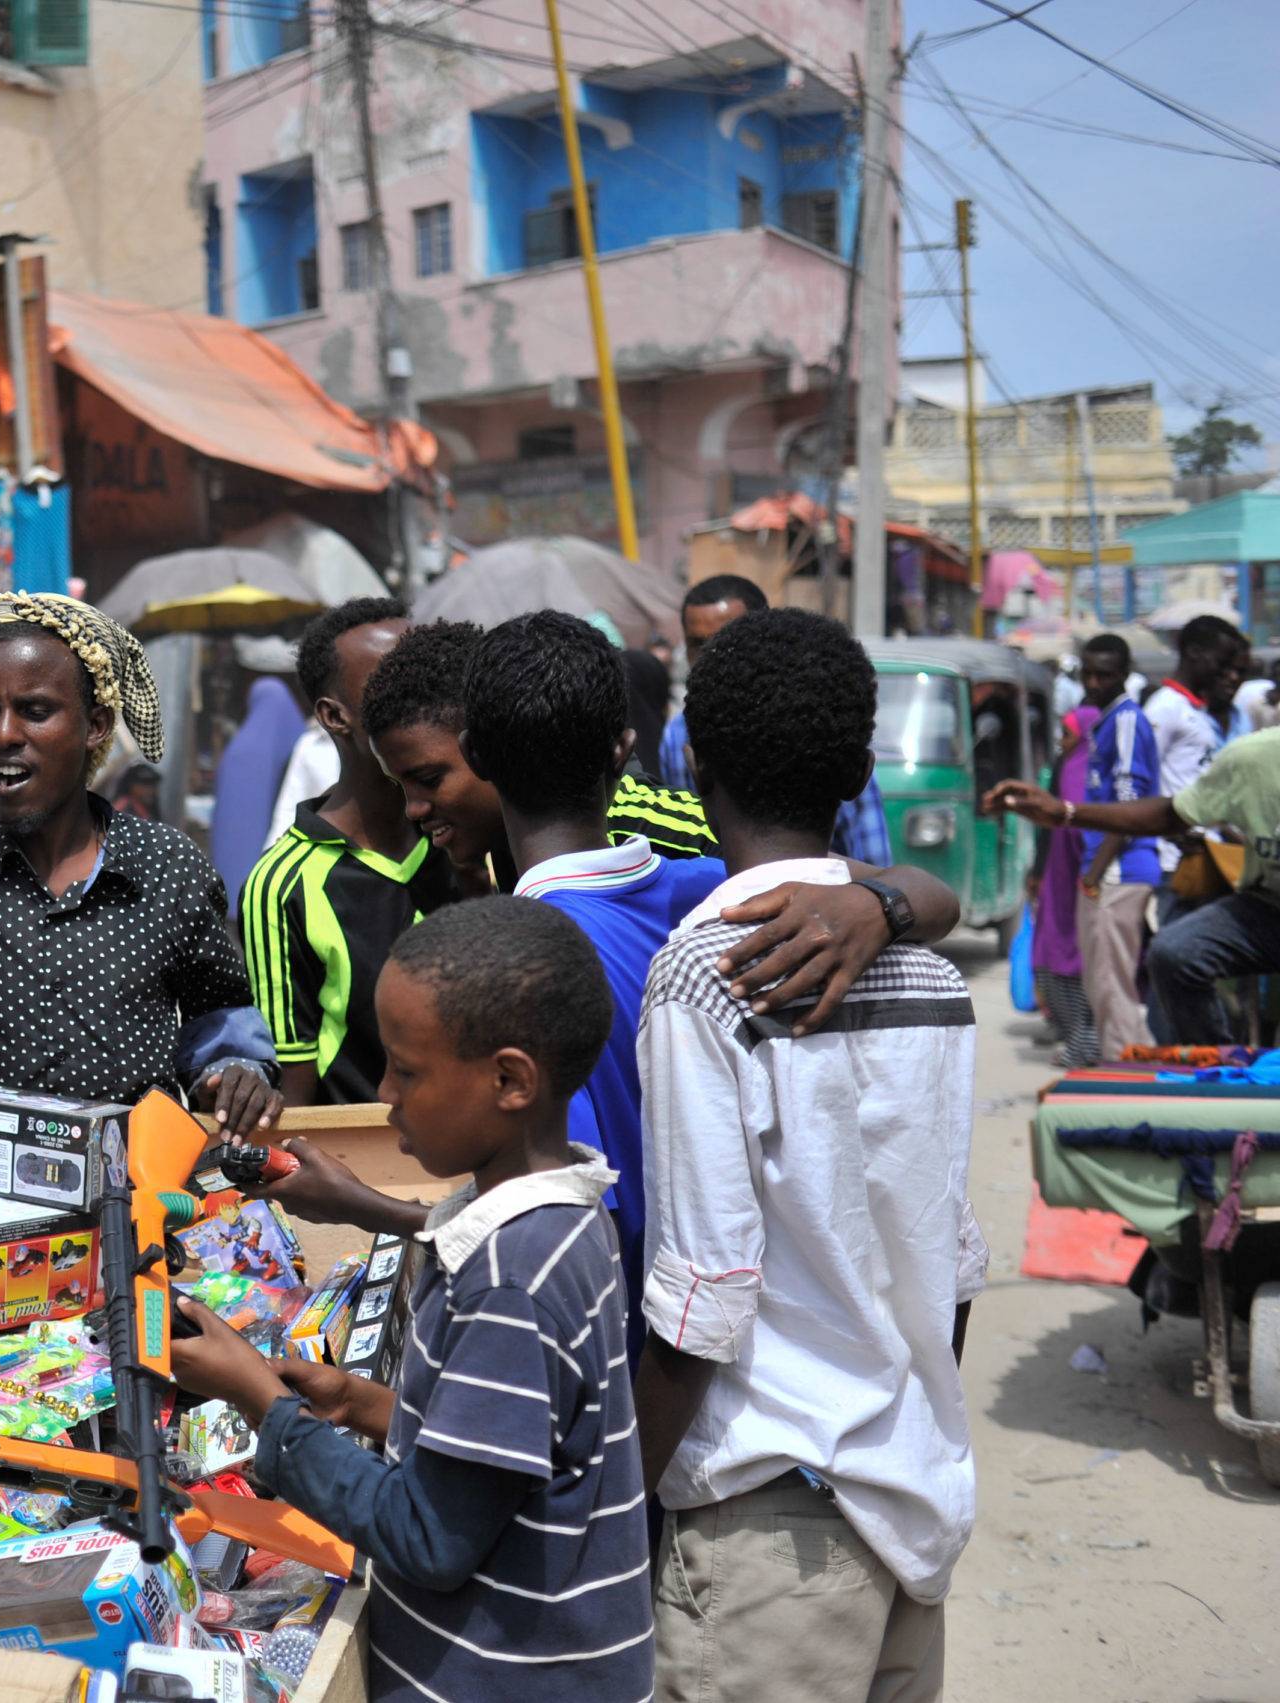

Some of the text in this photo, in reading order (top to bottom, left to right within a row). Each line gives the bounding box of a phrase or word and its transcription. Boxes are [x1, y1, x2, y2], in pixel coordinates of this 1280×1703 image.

[12, 1301, 53, 1323] Road
[26, 1543, 68, 1560] BUS
[75, 1533, 130, 1551] HOOL
[150, 1571, 169, 1612] SCHOOL
[100, 1606, 121, 1619] STOP
[141, 1580, 165, 1625] BUS
